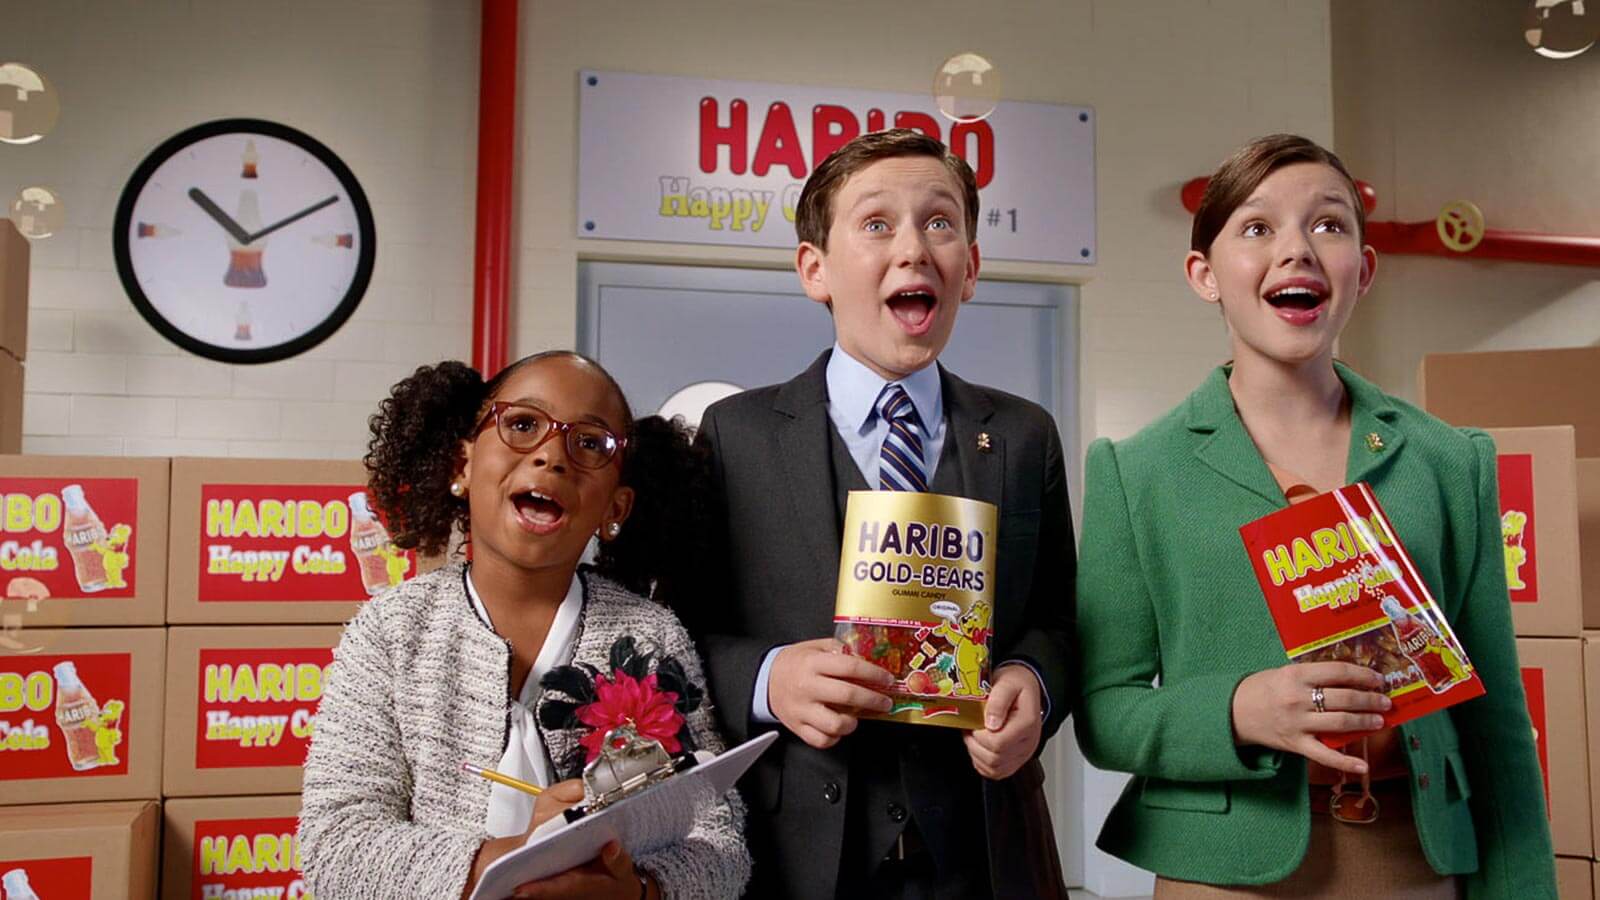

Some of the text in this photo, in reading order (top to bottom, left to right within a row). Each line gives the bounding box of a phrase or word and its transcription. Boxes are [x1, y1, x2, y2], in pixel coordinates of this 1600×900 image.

[658, 175, 774, 232] Happy
[986, 208, 1018, 233] #1
[206, 499, 349, 538] HARIBO
[858, 521, 985, 563] HARIBO
[207, 544, 346, 582] Happy Cola
[853, 560, 985, 592] GOLD-BEARS
[1293, 573, 1361, 613] Happy
[206, 710, 289, 747] Happy
